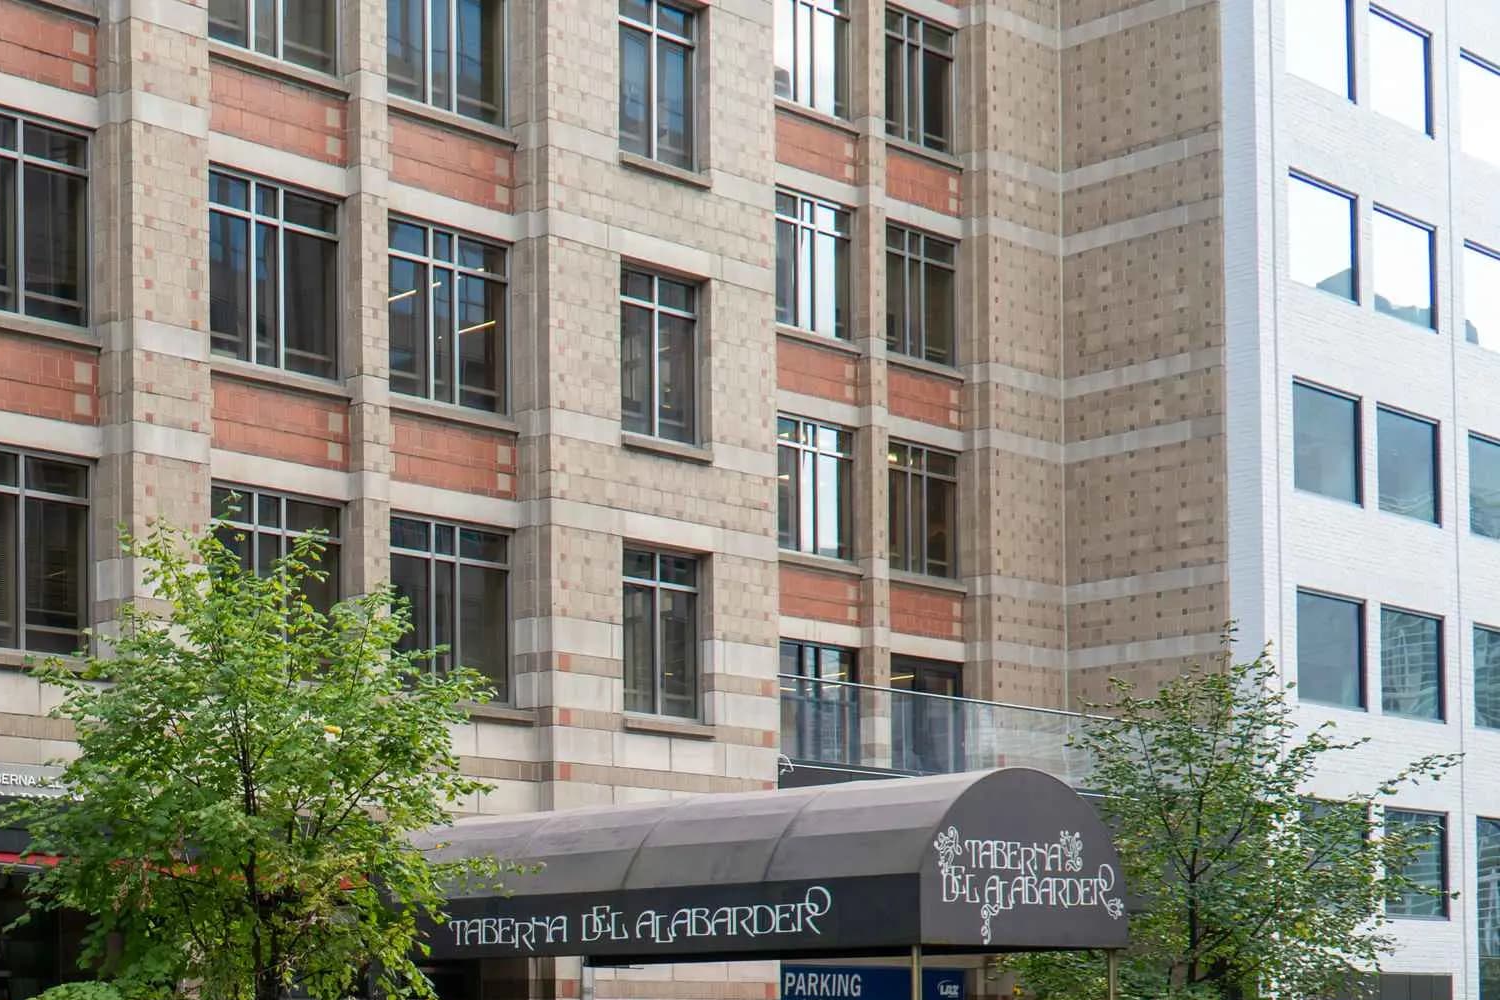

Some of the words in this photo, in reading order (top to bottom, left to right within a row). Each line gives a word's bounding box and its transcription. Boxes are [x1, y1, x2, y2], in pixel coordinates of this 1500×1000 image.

[964, 839, 1063, 877] TABERNA
[941, 866, 980, 903] DEL
[449, 915, 567, 951] TABERNA
[581, 905, 629, 942] DEL
[784, 973, 862, 997] PARKING
